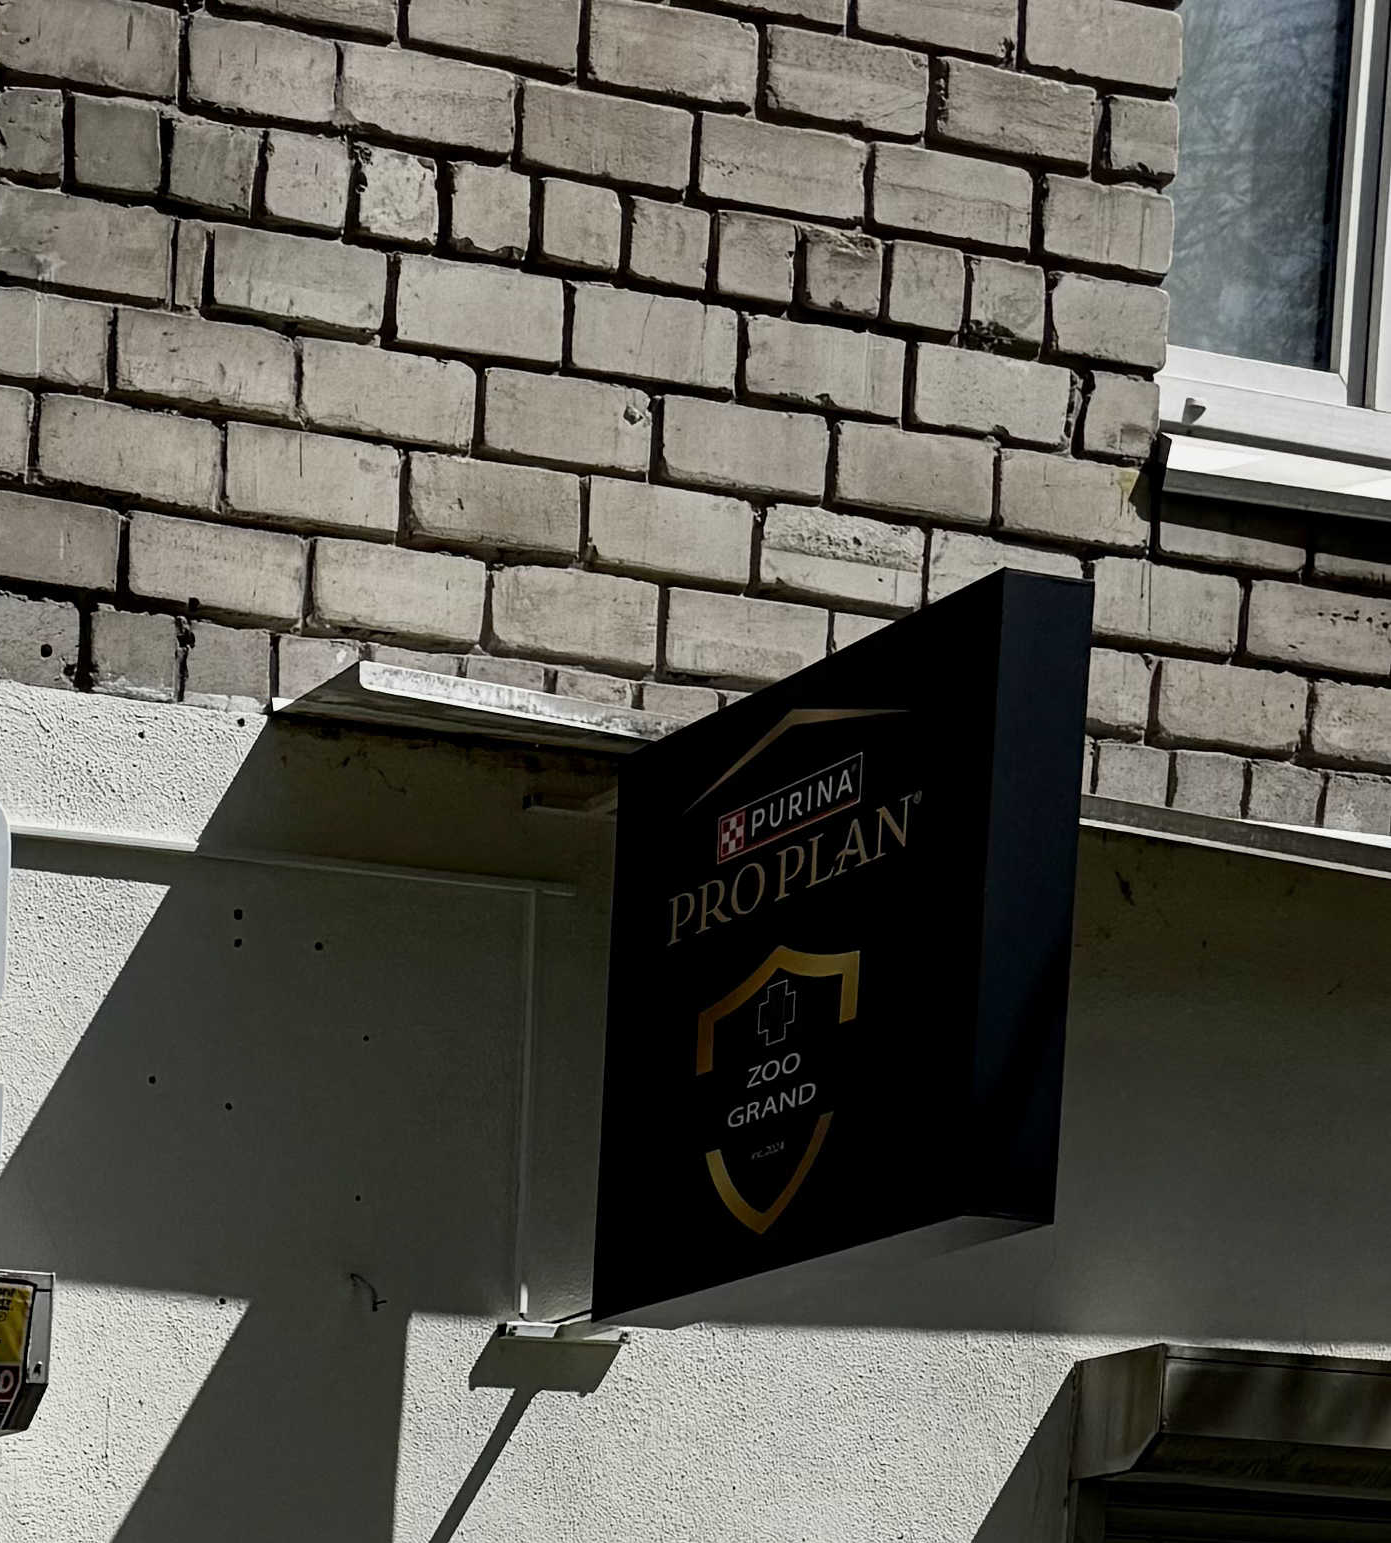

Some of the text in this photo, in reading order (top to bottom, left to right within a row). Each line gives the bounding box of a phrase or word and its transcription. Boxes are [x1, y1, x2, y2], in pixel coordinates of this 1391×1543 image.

[751, 769, 853, 837] PURINA
[746, 1052, 801, 1088] ZOO
[727, 1083, 817, 1128] GRAND
